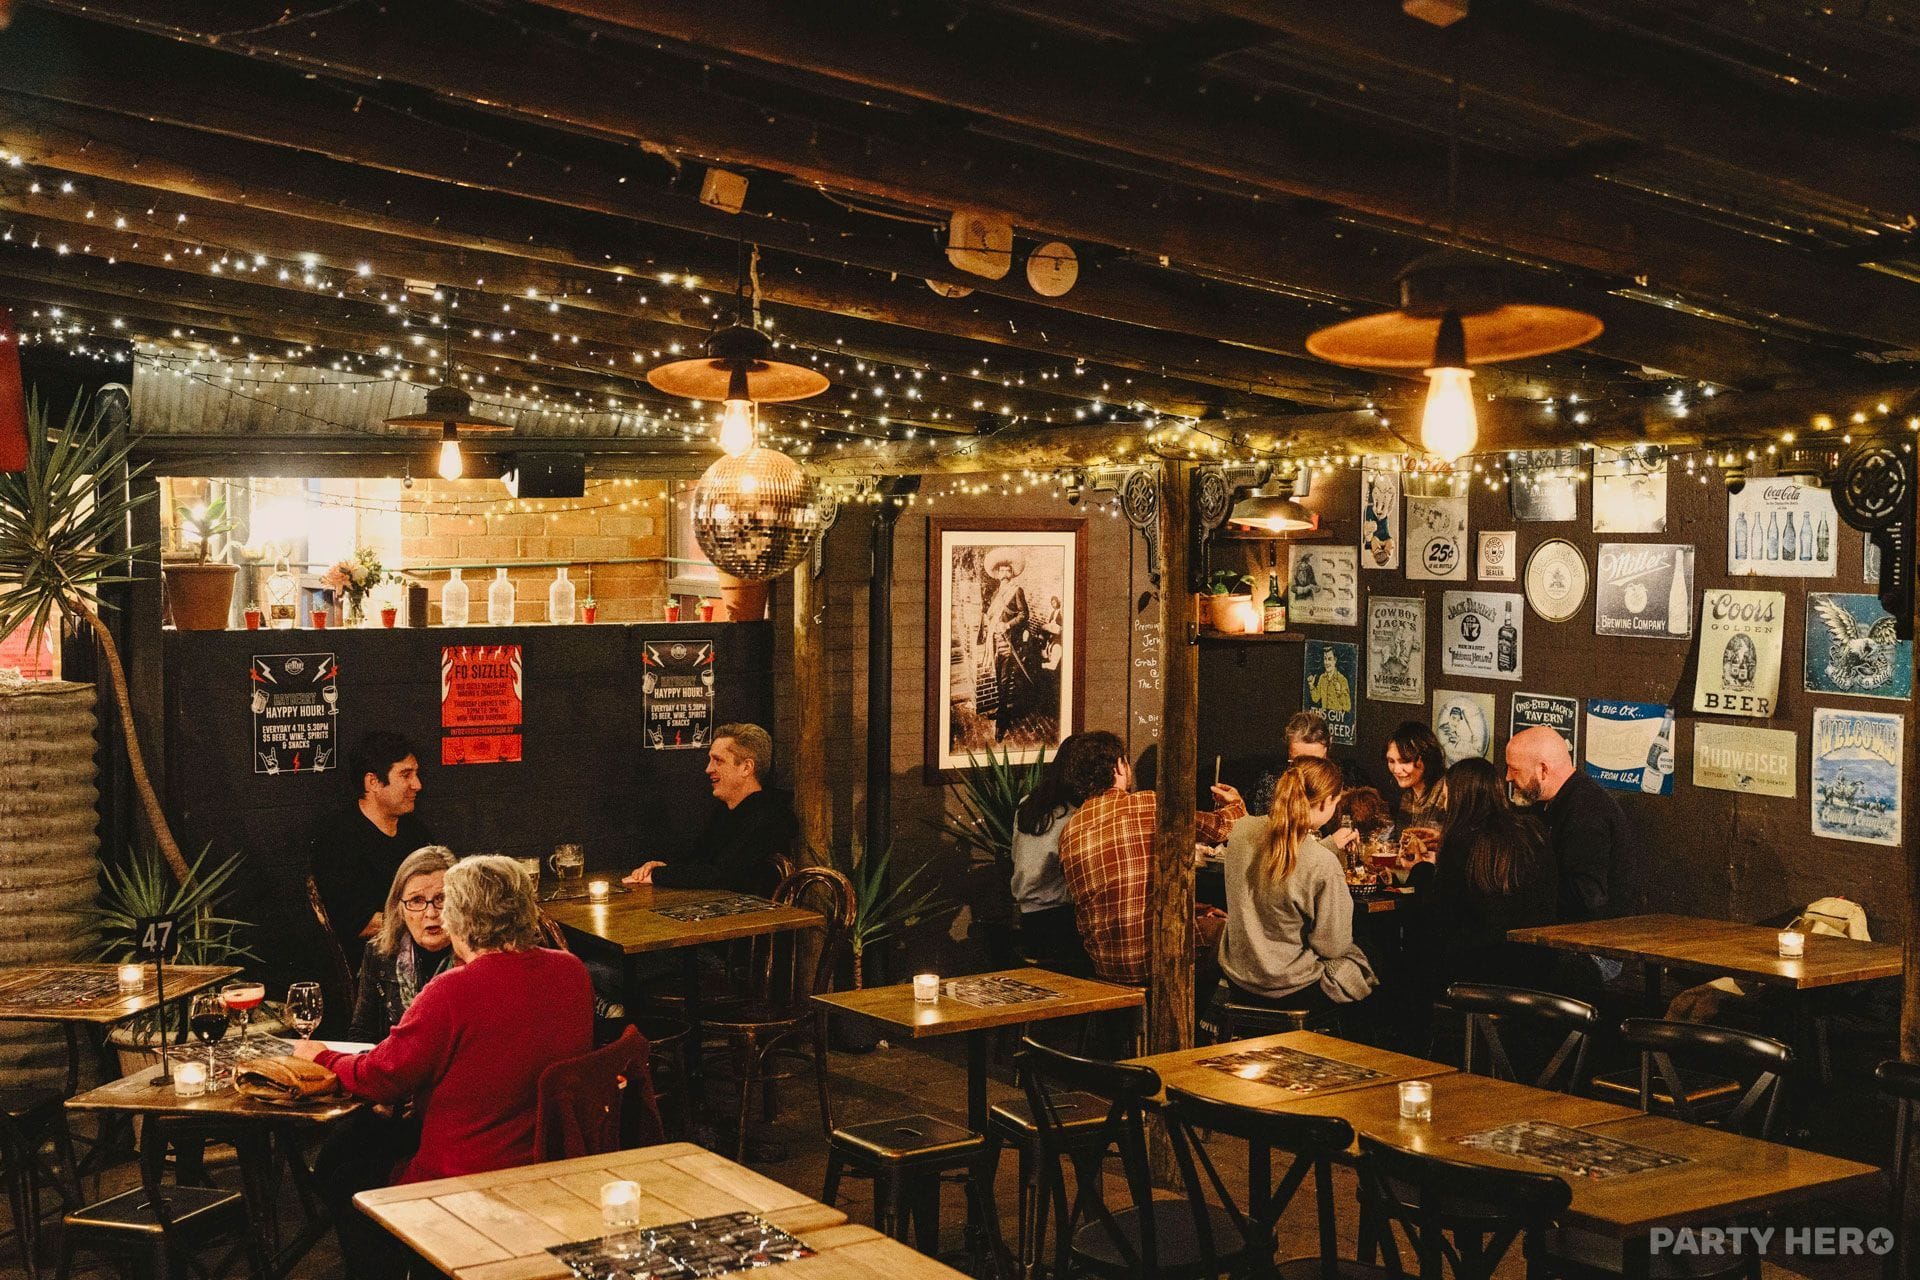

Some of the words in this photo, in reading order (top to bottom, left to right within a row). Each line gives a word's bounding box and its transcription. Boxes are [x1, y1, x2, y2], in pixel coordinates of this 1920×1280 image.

[1600, 552, 1666, 579] Miller
[1374, 608, 1418, 622] COWBOY
[1711, 594, 1774, 622] Coors
[1375, 620, 1416, 632] JACK'S
[1602, 615, 1632, 629] BREWING
[1632, 616, 1666, 630] COMPANY
[1711, 624, 1774, 634] GOLDEN
[1135, 658, 1157, 667] Grab
[456, 665, 468, 679] FO
[472, 664, 509, 679] SIZZLE!
[654, 688, 681, 698] HAYPPY
[682, 687, 703, 698] HOUR!
[1516, 700, 1550, 713] ONE-EYED
[1550, 702, 1574, 718] JACK'S
[1602, 706, 1617, 714] BIG
[1705, 692, 1769, 714] BEER
[266, 706, 298, 718] HAYPPY
[300, 705, 324, 716] HOUR!
[1328, 709, 1345, 722] GUY
[1524, 710, 1564, 724] TAVERN
[262, 725, 290, 734] EVERYDAY
[307, 723, 328, 731] 5.30PM
[1329, 724, 1355, 740] BEER!
[272, 733, 288, 742] BEER,
[290, 733, 306, 741] WINE,
[308, 731, 328, 739] SPIRITS
[288, 741, 310, 749] SNACKS
[1700, 746, 1788, 775] BUDWEISER
[142, 921, 172, 952] 47
